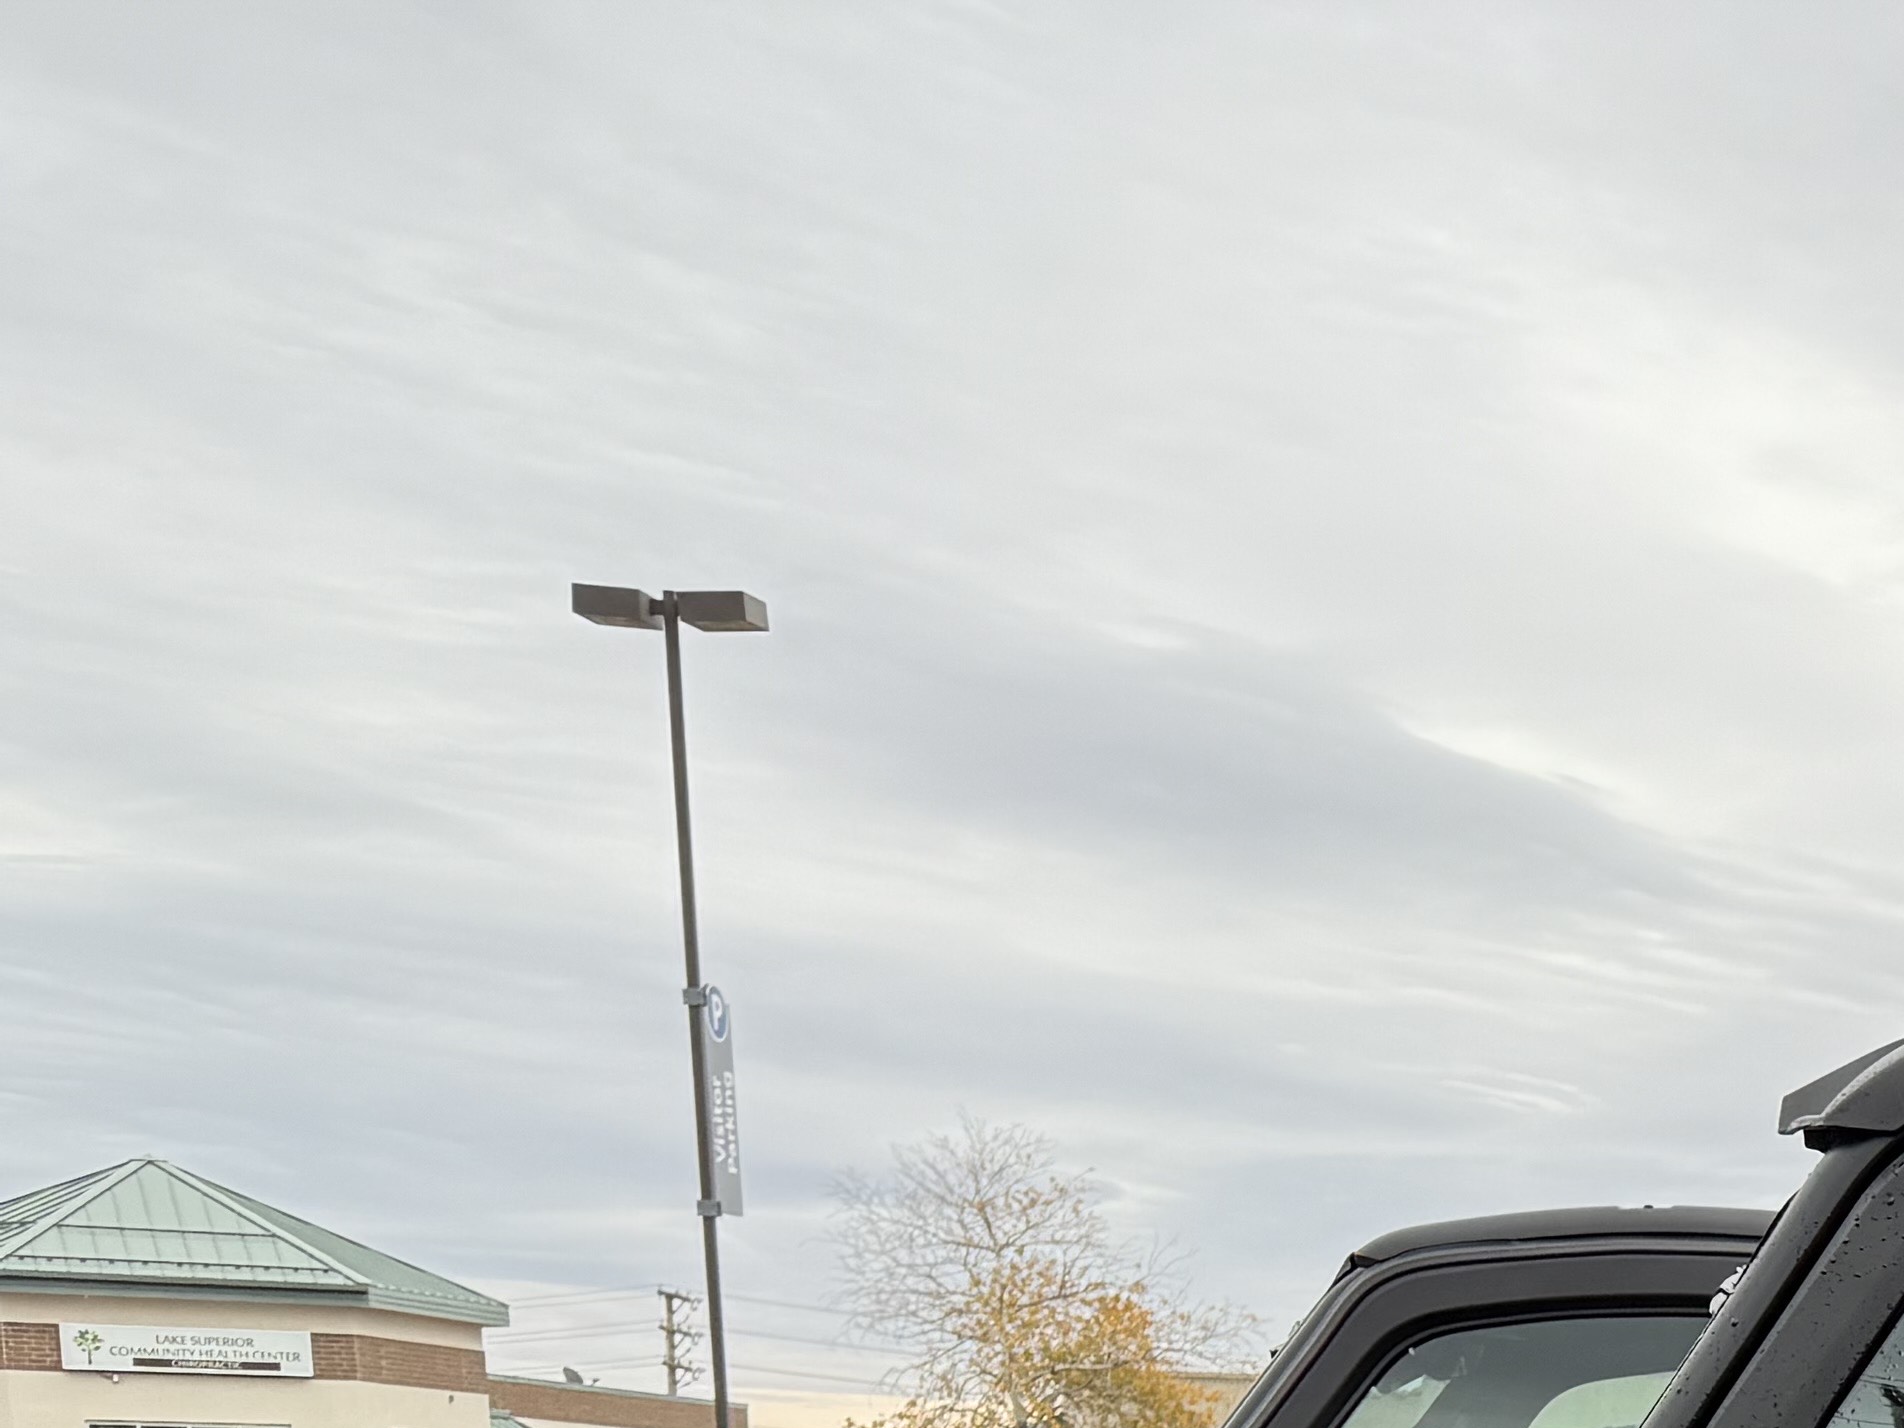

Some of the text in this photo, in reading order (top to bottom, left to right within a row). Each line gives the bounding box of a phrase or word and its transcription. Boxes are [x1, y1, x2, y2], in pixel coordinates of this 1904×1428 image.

[712, 1074, 727, 1164] Visitor
[723, 1071, 738, 1174] Parking
[109, 1345, 301, 1363] COMMUNITY HEALTH CENTER
[155, 1334, 255, 1348] LAKE SUPERIOR
